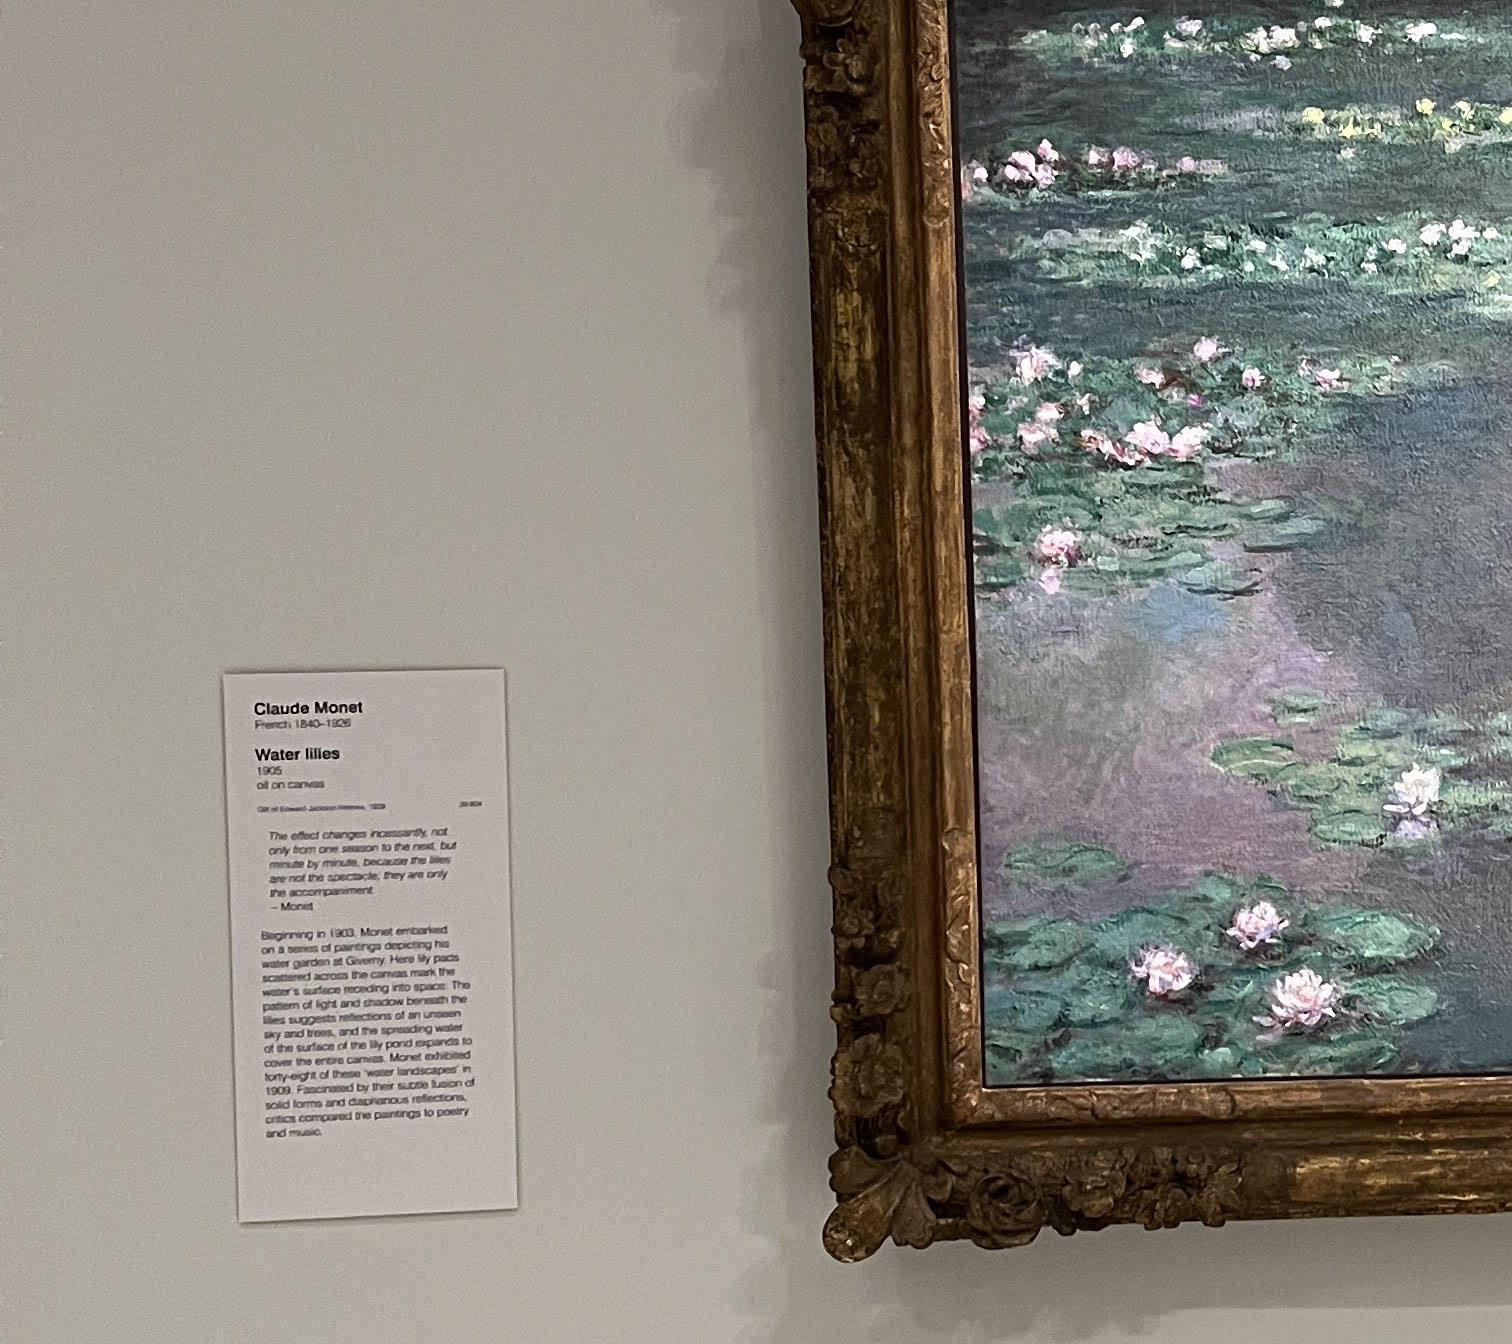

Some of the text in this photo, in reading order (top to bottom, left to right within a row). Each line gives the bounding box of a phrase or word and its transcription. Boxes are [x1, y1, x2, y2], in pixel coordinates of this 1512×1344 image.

[253, 701, 362, 715] Claude Monet
[254, 720, 291, 730] French
[255, 746, 340, 762] Water lilies
[257, 766, 282, 776] 1905
[256, 780, 269, 790] oil
[287, 781, 325, 789] canvas
[269, 831, 288, 841] The
[290, 830, 319, 840] effect
[321, 829, 367, 841] changes
[430, 826, 448, 836] not
[268, 845, 290, 857] only
[292, 844, 316, 854] from
[341, 845, 379, 853] season
[381, 842, 392, 852] to
[393, 842, 410, 851] the
[439, 840, 457, 850] but
[268, 859, 304, 869] minute
[306, 858, 319, 870] by
[362, 856, 408, 866] because
[409, 855, 427, 865] the
[288, 873, 306, 883] not
[307, 872, 324, 882] the
[383, 870, 406, 882] they
[426, 869, 448, 880] only
[269, 888, 286, 897] the
[280, 901, 313, 911] Monet
[260, 929, 313, 942] Beginning
[316, 929, 326, 938] in
[359, 927, 393, 937] Monet
[395, 925, 448, 936] embarked
[277, 946, 285, 954] a
[287, 943, 318, 953] series
[320, 943, 331, 952] of
[333, 941, 381, 954] paintings
[383, 939, 432, 952] depicting
[434, 939, 449, 948] his
[261, 958, 290, 968] water
[292, 957, 330, 969] garden
[332, 956, 343, 966] at
[389, 954, 415, 964] Here
[417, 953, 431, 965] lily
[432, 952, 460, 964] pads
[262, 967, 455, 982] scattered across the canvas mark the
[261, 986, 300, 997] water's
[302, 985, 341, 995] surface
[343, 983, 389, 996] receding
[391, 982, 411, 992] into
[451, 980, 471, 989] The
[262, 994, 467, 1013] pattern of light and shadow beneath the
[288, 1013, 336, 1026] suggests
[338, 1011, 392, 1022] reflections
[394, 1010, 405, 1020] of
[423, 1010, 461, 1019] unseen
[263, 1029, 281, 1041] sky
[283, 1028, 305, 1038] and
[338, 1026, 359, 1036] and
[361, 1025, 378, 1035] the
[380, 1023, 433, 1036] spreading
[434, 1022, 463, 1032] water
[263, 1036, 473, 1053] of the surface of the lily pond expands to
[263, 1059, 293, 1067] cover
[295, 1056, 312, 1066] the
[314, 1055, 344, 1065] entire
[389, 1052, 422, 1062] Monet
[318, 1070, 329, 1079] of
[332, 1068, 361, 1079] these
[462, 1064, 471, 1073] in
[356, 1082, 369, 1094] by
[371, 1081, 394, 1091] their
[431, 1078, 462, 1089] fusion
[464, 1078, 475, 1087] of
[264, 1100, 290, 1110] solid
[292, 1098, 323, 1109] forms
[324, 1097, 345, 1107] and
[264, 1106, 469, 1124] critics compared the paintings to poetry
[265, 1128, 286, 1138] and
